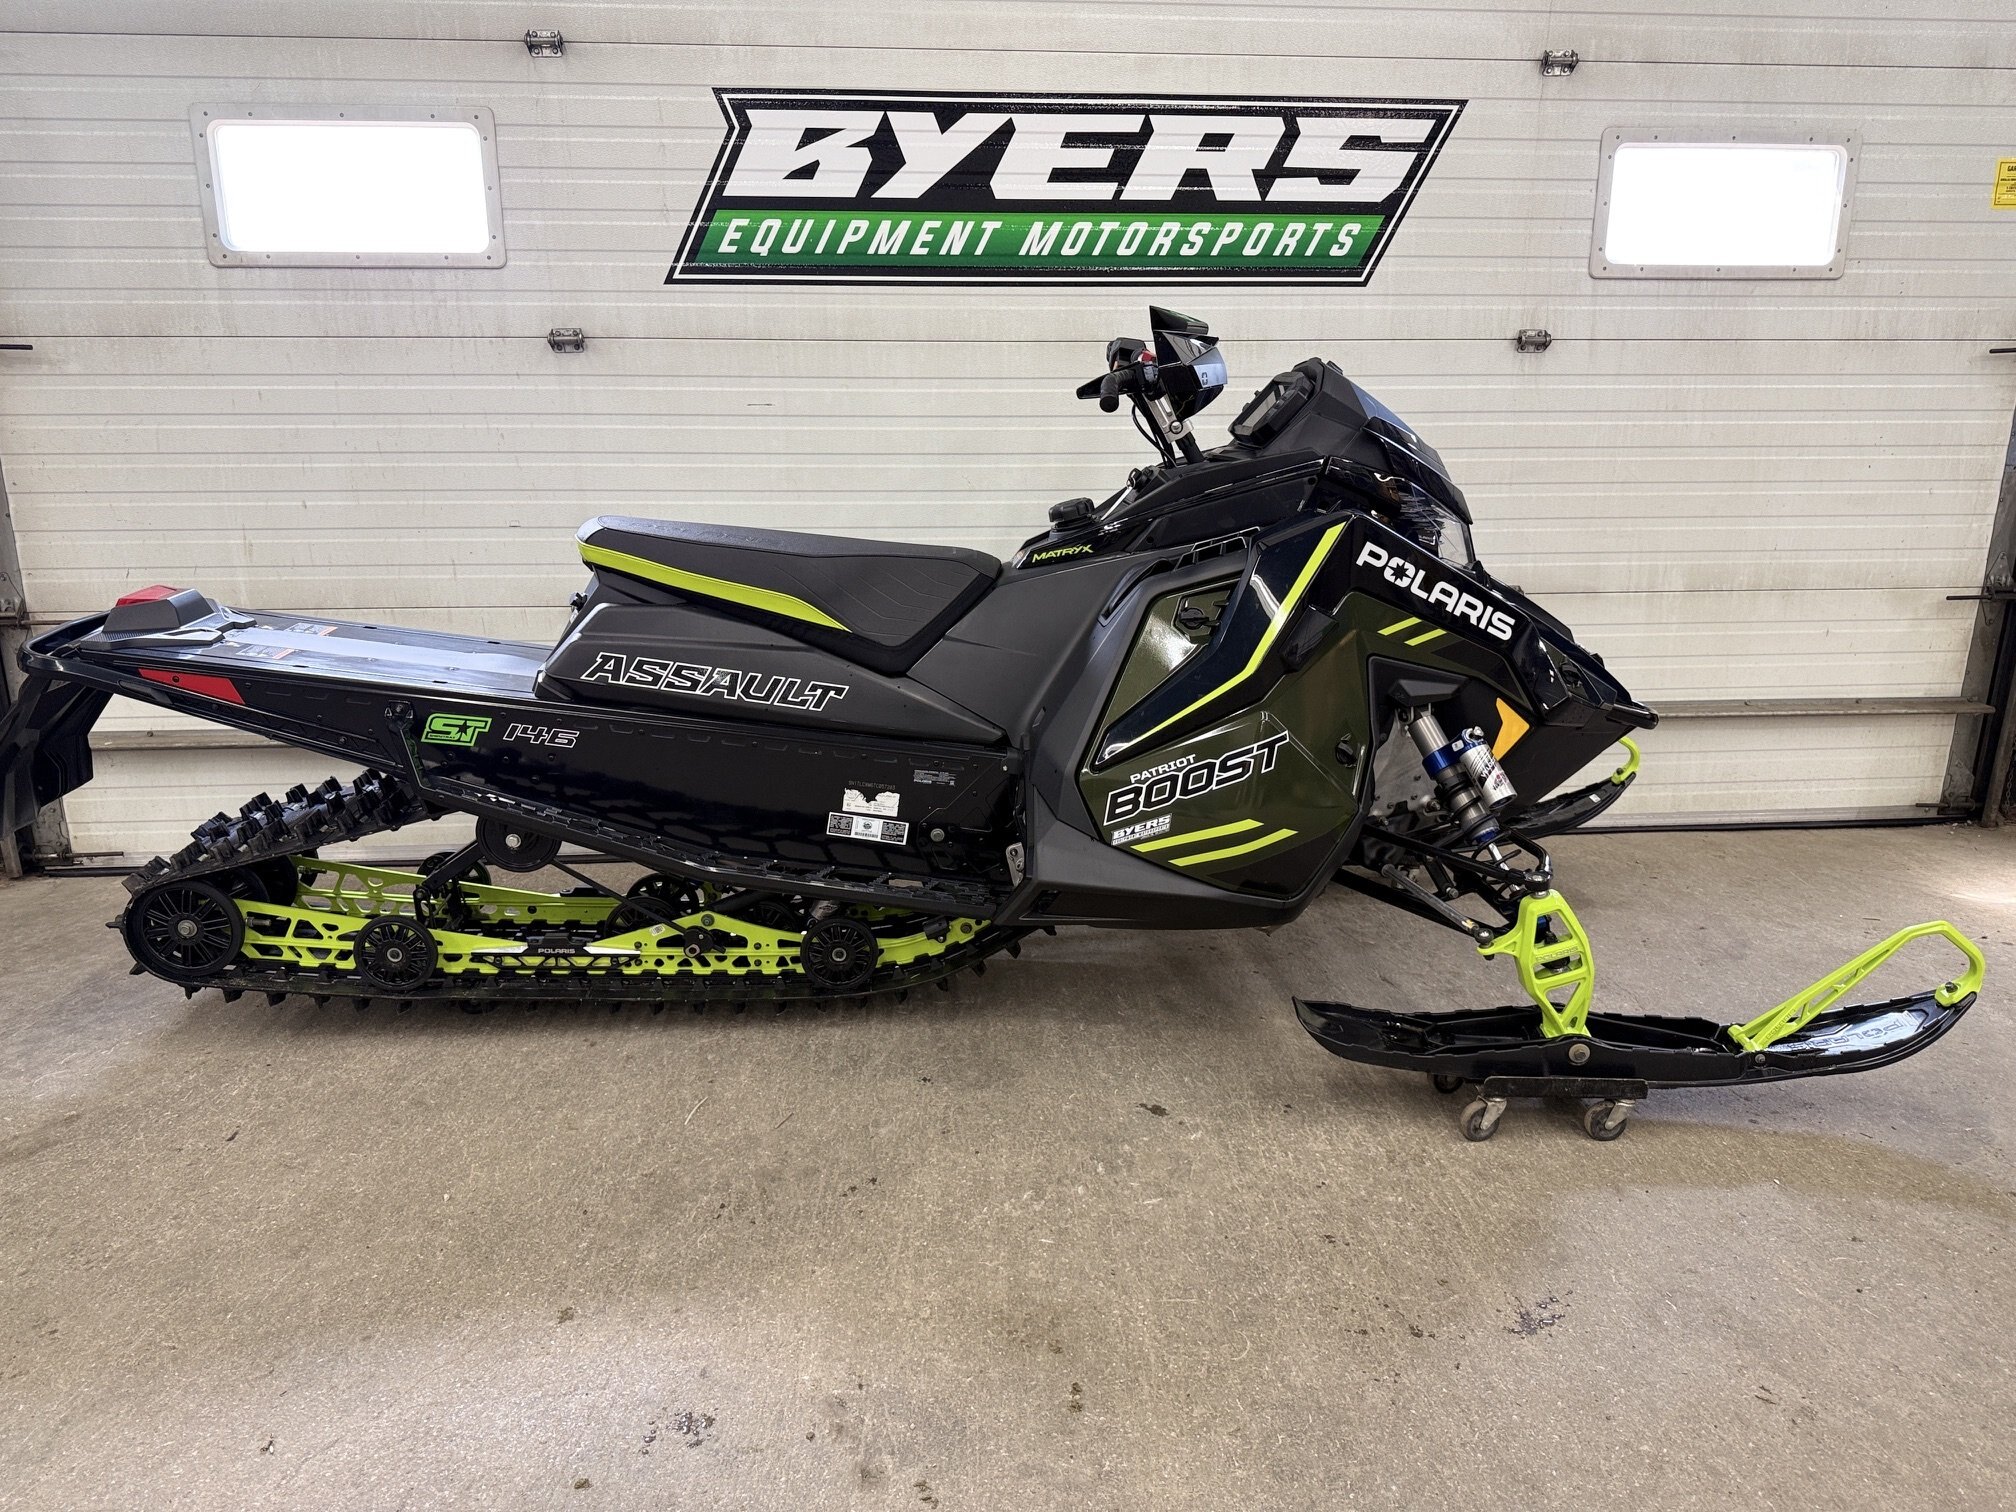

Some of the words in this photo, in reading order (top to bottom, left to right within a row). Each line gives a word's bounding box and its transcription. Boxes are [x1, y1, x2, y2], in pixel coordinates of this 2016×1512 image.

[722, 108, 1436, 202] BYERS
[717, 217, 1002, 257] EQUIPMENT
[1018, 218, 1364, 258] MOTORSPORTS
[1031, 543, 1094, 563] MATRYX
[1355, 541, 1516, 641] POLARIS
[581, 651, 849, 711] ASSAULT
[424, 715, 491, 745] ST
[503, 722, 580, 748] 146
[1103, 731, 1290, 826] BOOST
[1130, 754, 1196, 783] PATRIOT
[1113, 815, 1171, 840] BYERS
